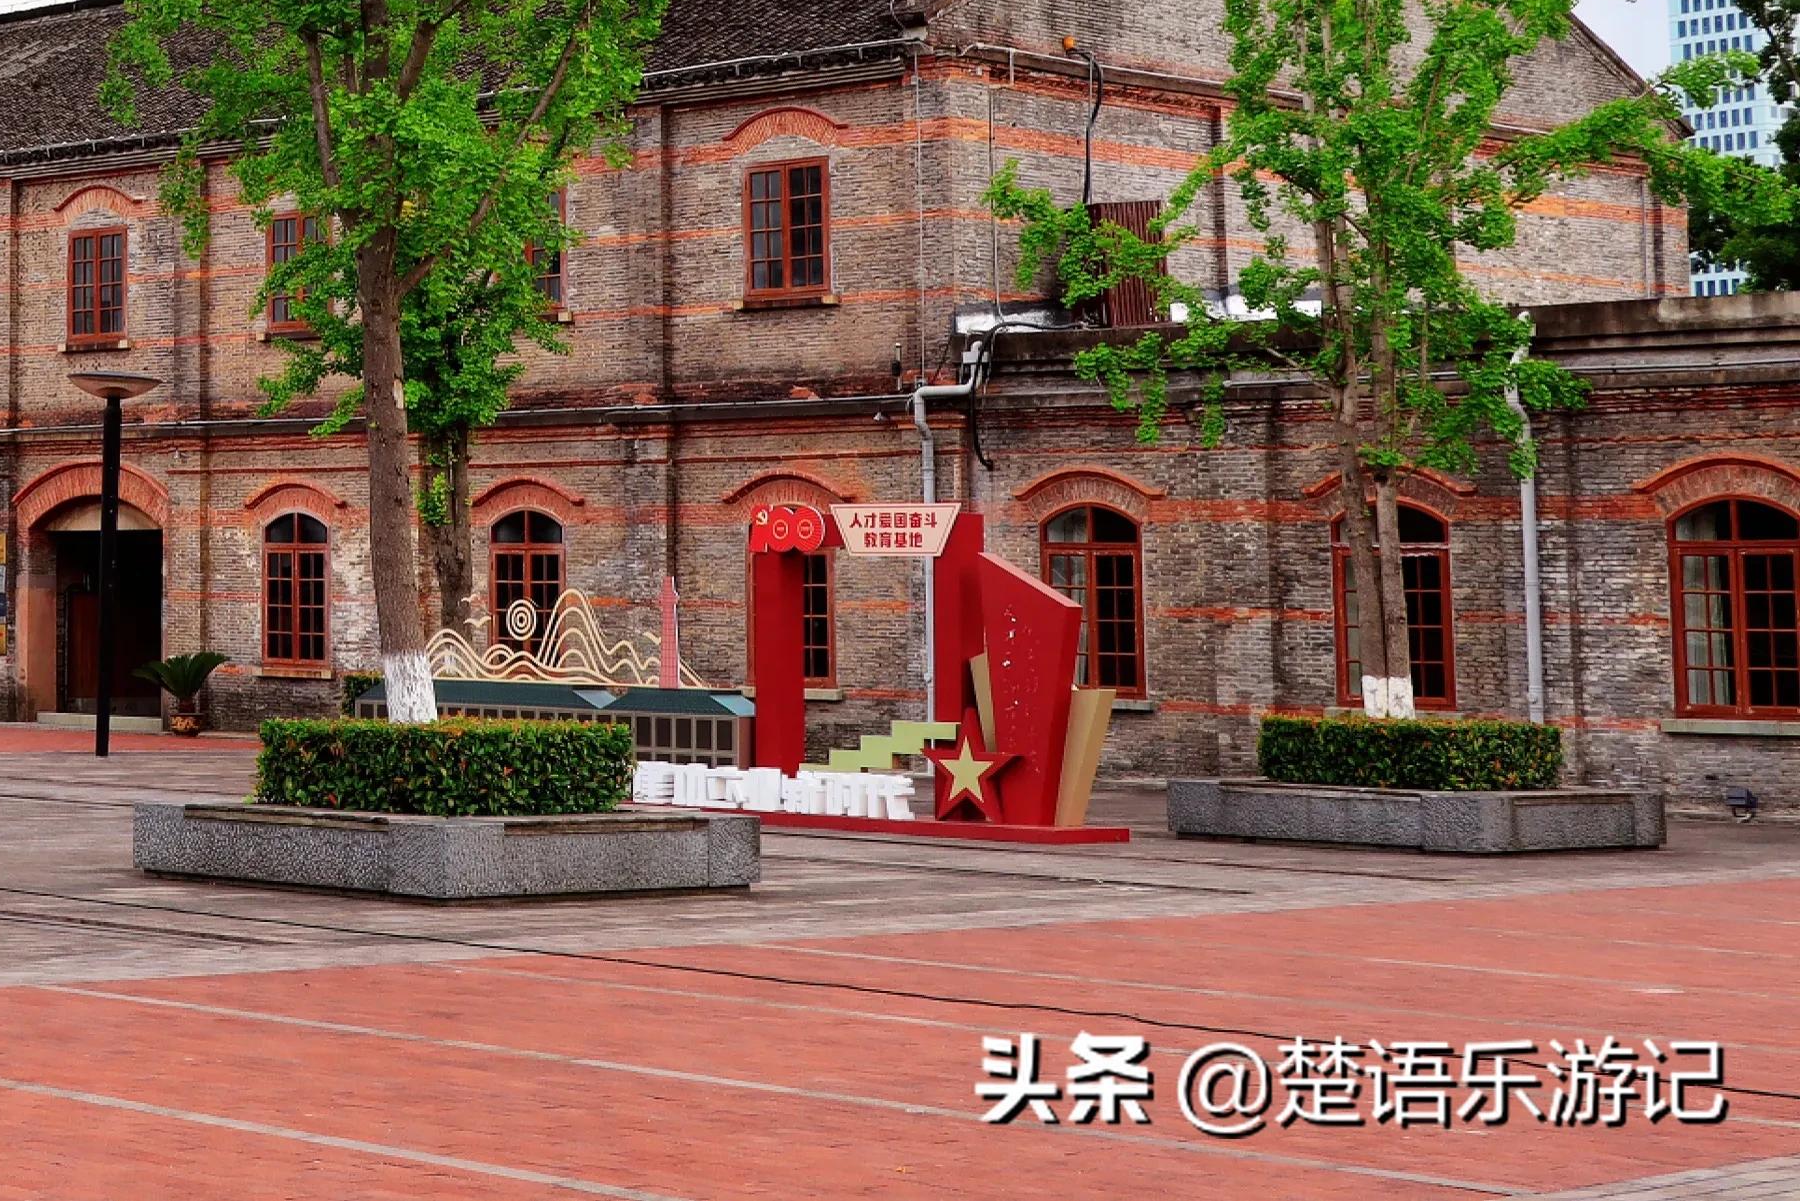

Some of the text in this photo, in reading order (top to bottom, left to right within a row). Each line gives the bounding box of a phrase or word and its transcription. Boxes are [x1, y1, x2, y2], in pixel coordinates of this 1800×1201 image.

[849, 512, 937, 528] 人才爱国奋斗
[864, 532, 922, 548] 教育基地
